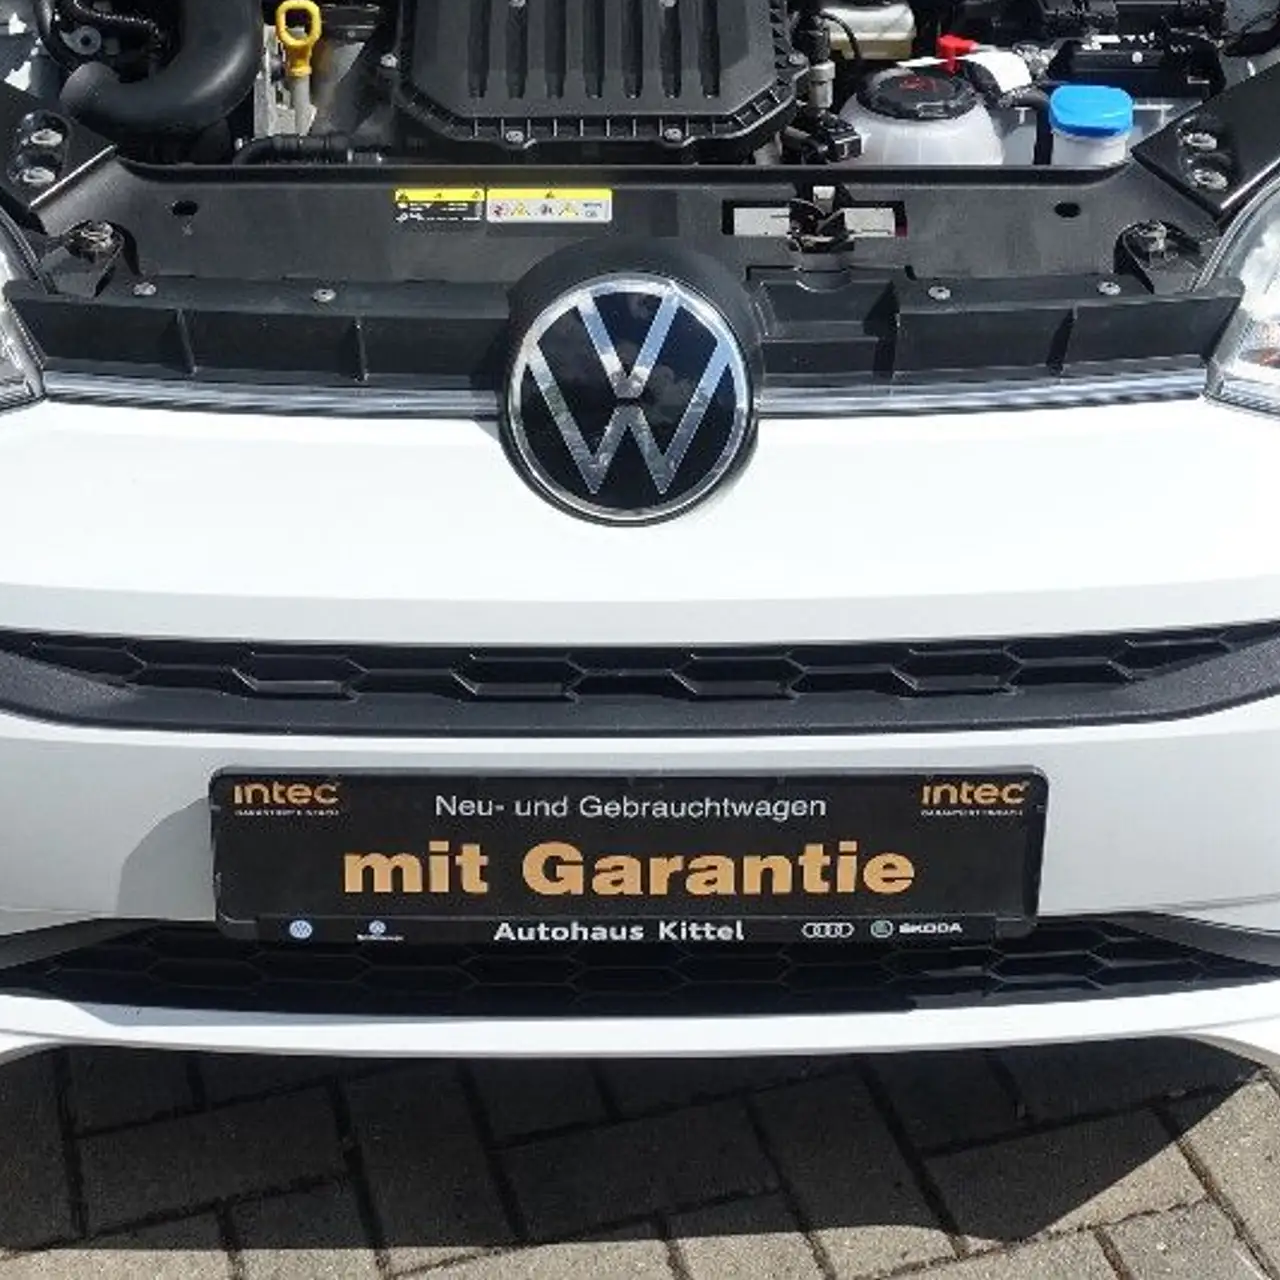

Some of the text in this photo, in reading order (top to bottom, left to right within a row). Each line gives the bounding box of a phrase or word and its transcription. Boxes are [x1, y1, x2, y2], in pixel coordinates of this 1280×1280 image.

[234, 781, 340, 805] intec
[922, 780, 1028, 805] intec
[435, 794, 828, 822] Neu- und Gebrauchtwagen
[344, 839, 915, 895] mit Garantie
[493, 921, 745, 942] Autohaus Kittel
